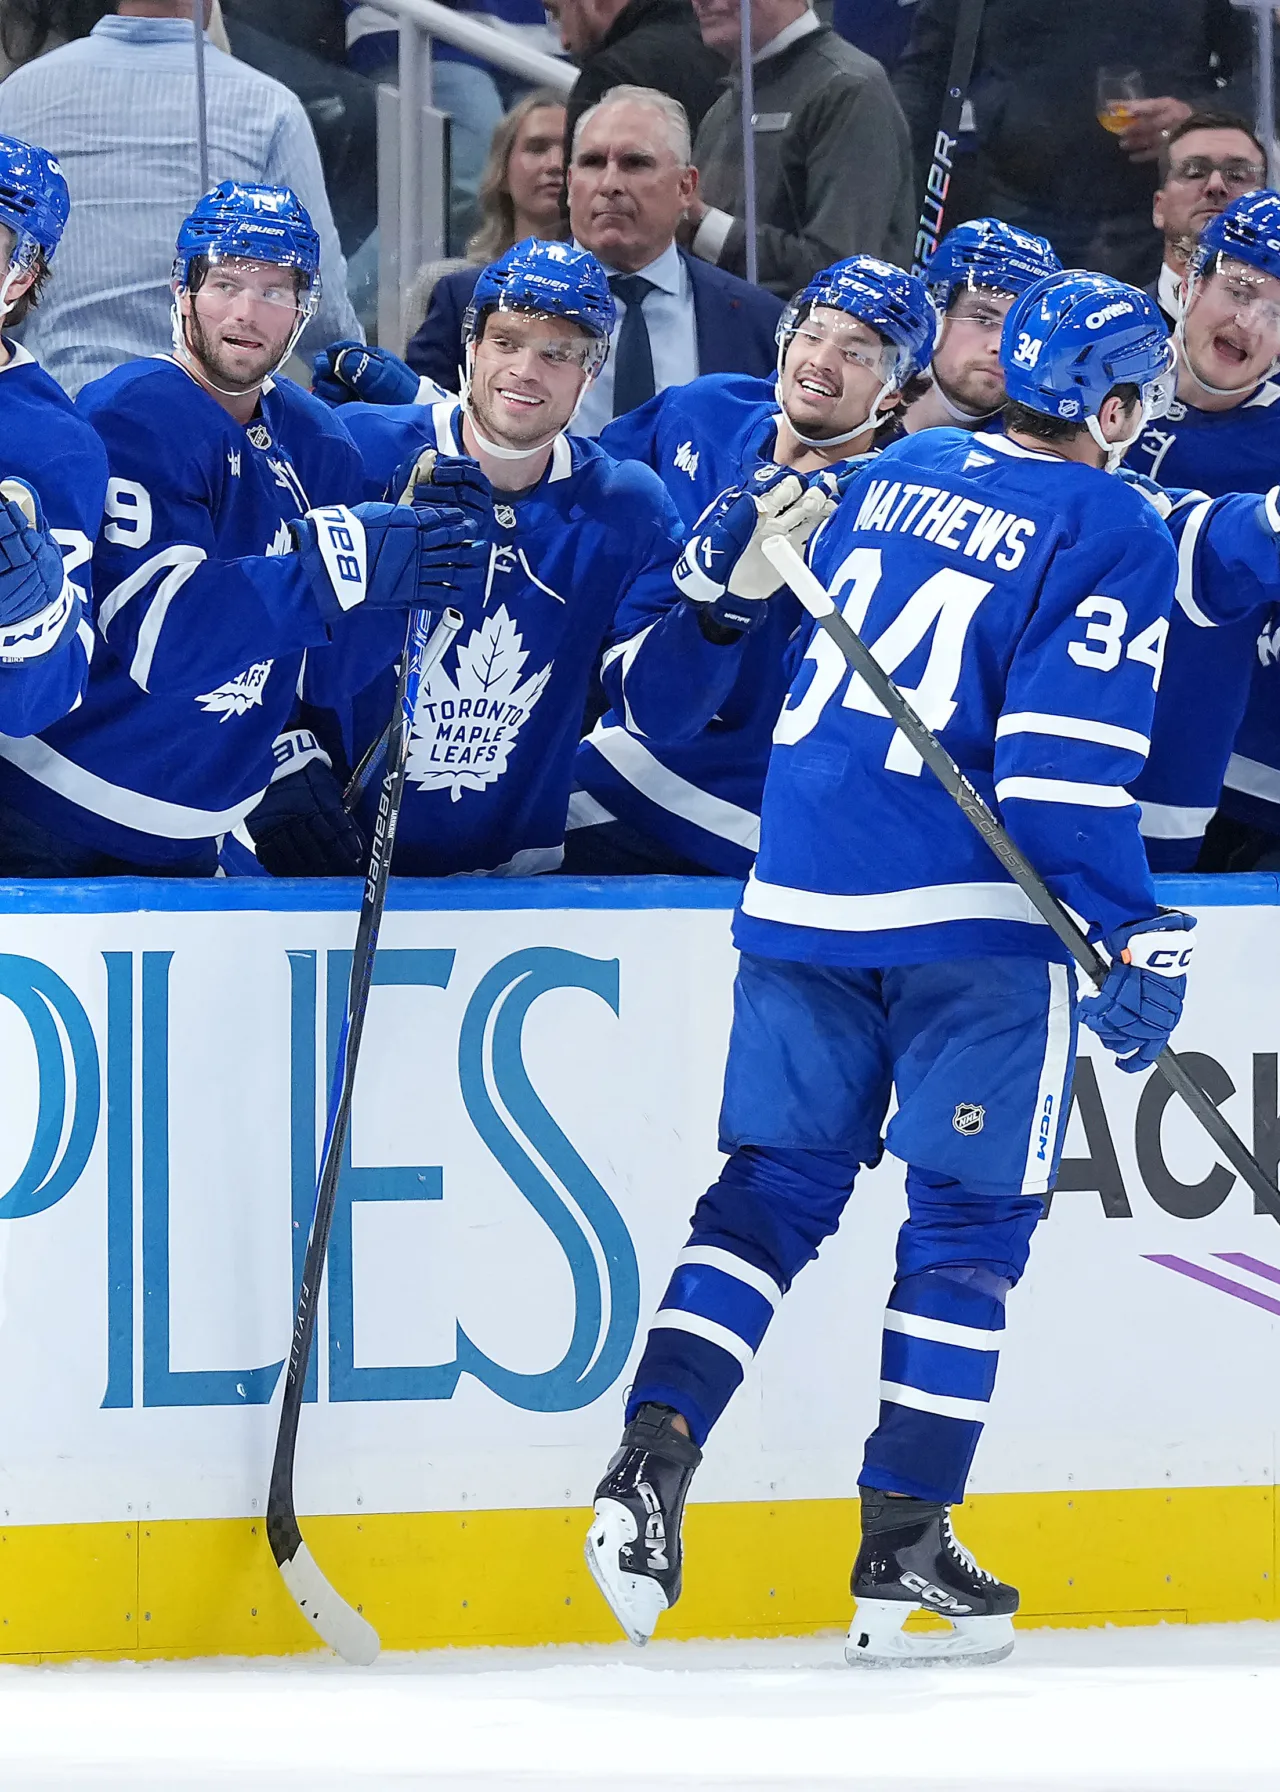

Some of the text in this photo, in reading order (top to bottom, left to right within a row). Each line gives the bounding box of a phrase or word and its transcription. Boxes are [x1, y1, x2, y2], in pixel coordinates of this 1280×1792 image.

[1013, 332, 1043, 368] 34
[853, 479, 1036, 572] MATTHEWS
[771, 546, 995, 777] 34
[1067, 594, 1170, 694] 34
[422, 697, 524, 727] TORONTO
[435, 722, 507, 744] MAPLE
[429, 743, 498, 764] LEAFS
[1036, 1094, 1054, 1162] CCM
[636, 1482, 669, 1571] CCM
[899, 1570, 973, 1613] CCM
